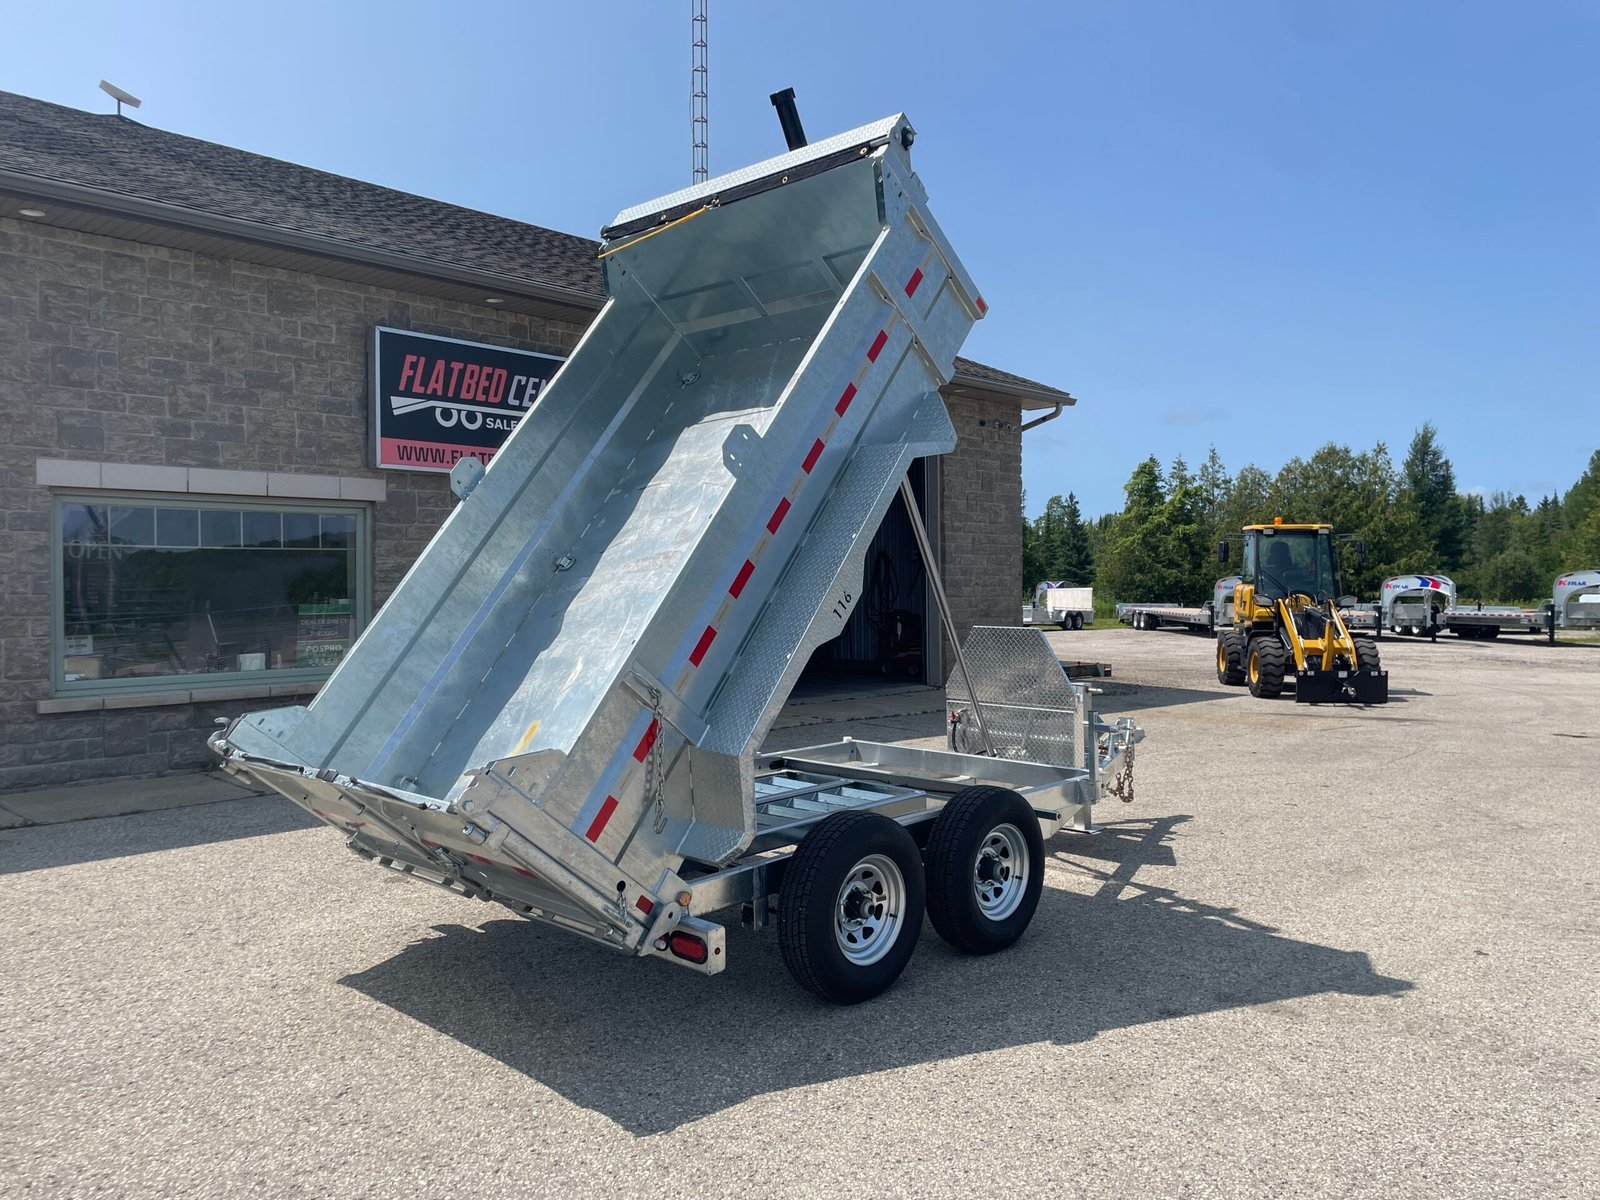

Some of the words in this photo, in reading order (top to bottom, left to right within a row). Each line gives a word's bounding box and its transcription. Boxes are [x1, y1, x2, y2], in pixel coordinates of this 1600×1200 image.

[398, 354, 508, 404] FLATBED
[68, 539, 122, 560] OPEN
[833, 590, 852, 619] 116
